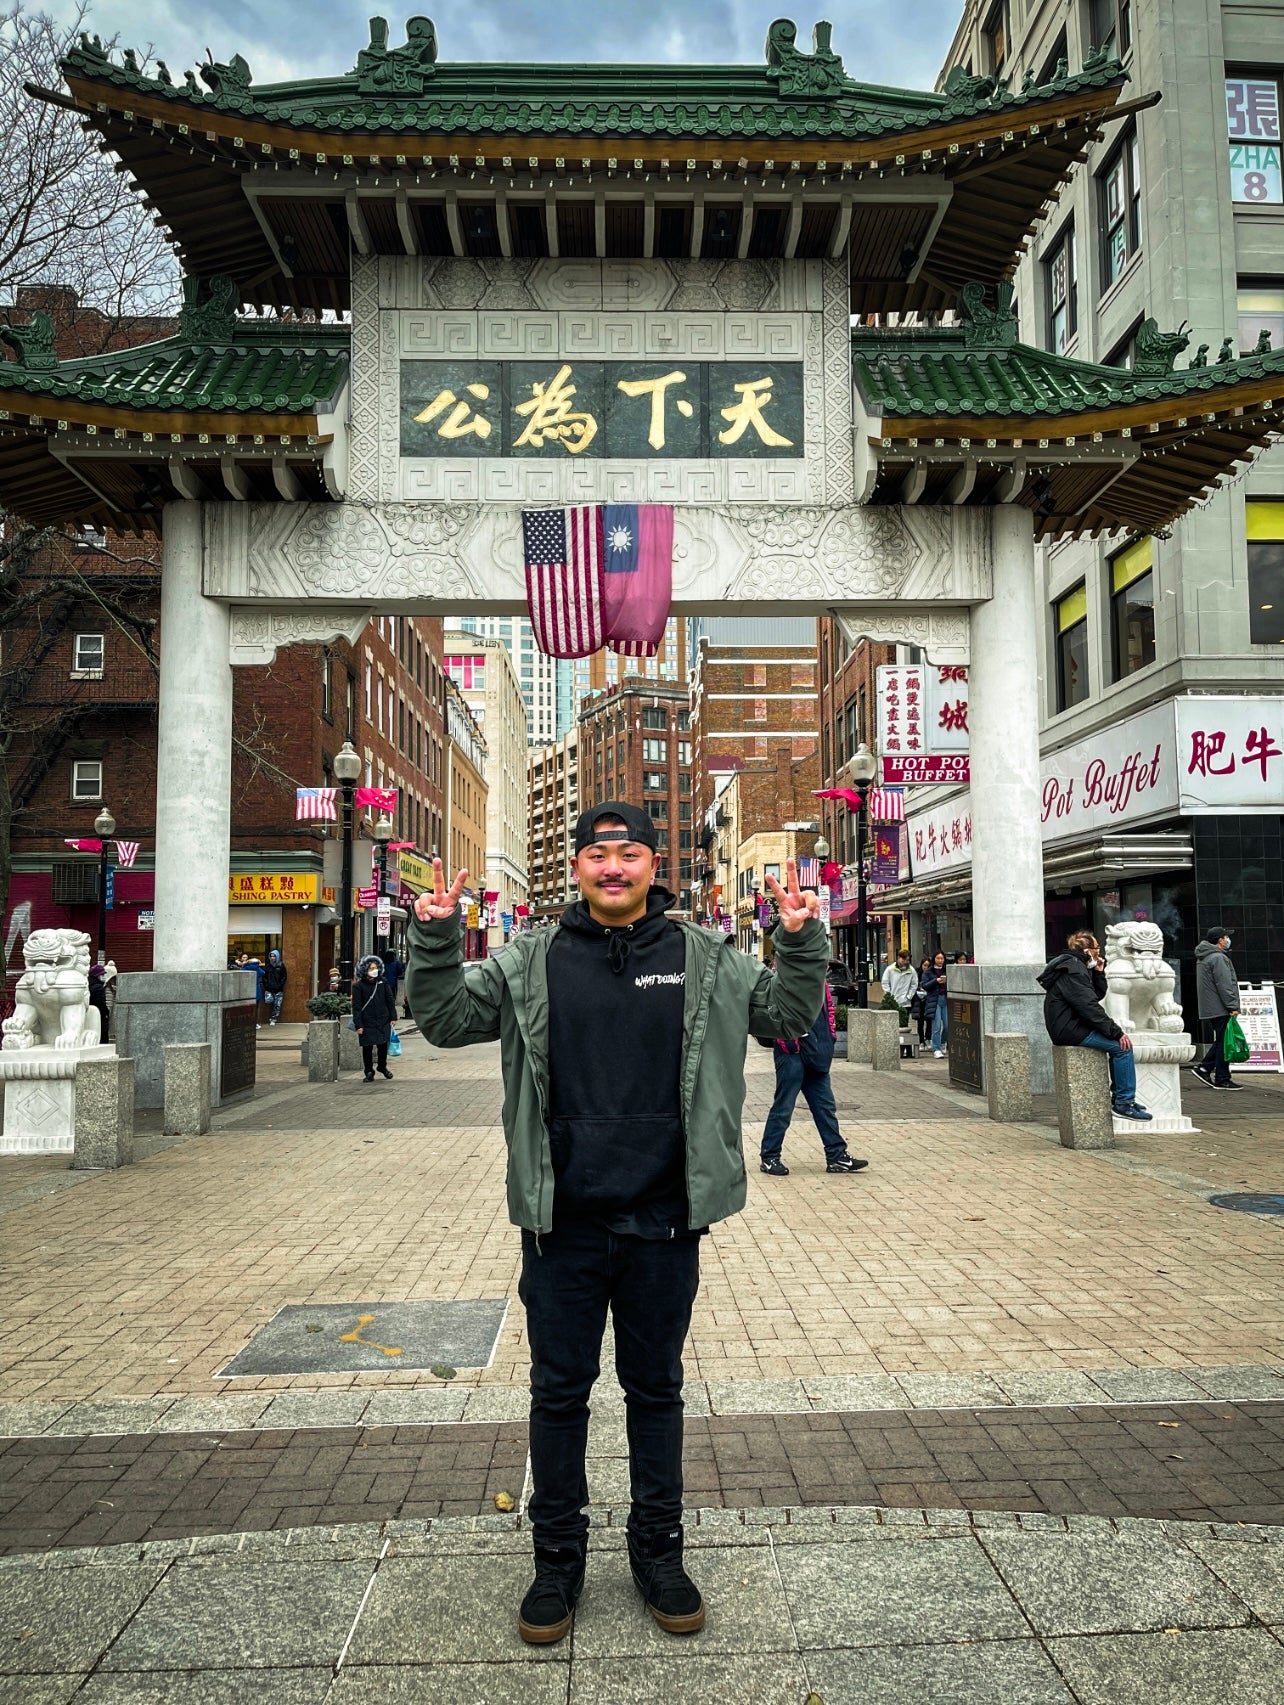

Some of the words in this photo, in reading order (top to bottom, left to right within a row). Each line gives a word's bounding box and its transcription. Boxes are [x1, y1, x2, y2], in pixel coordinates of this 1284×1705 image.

[1226, 84, 1278, 136] 張
[1243, 172, 1268, 201] 8
[891, 758, 930, 770] HOT
[1188, 727, 1283, 782] 肥牛
[902, 770, 967, 782] BUFFET
[1040, 777, 1074, 822] Pot
[1082, 744, 1161, 813] Buffet
[232, 891, 266, 900] SHING
[271, 891, 312, 900] PASTRY
